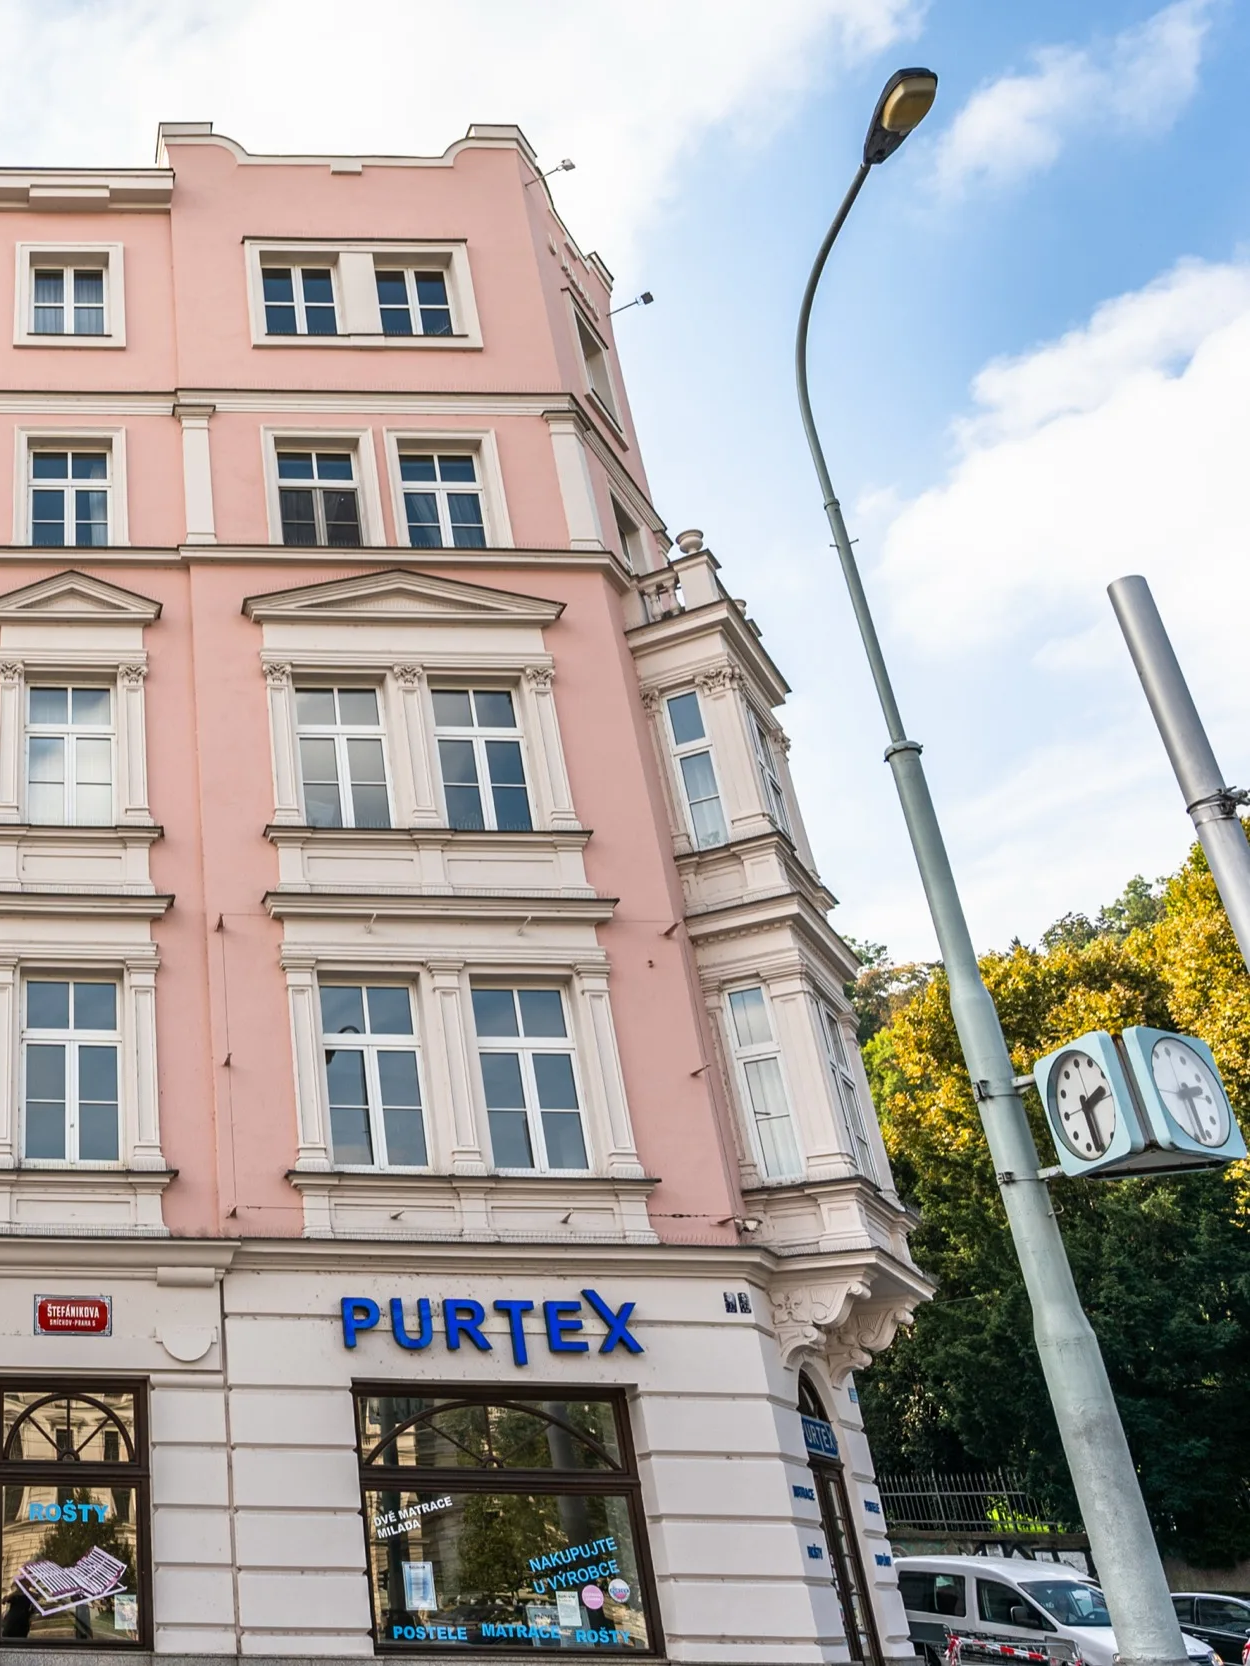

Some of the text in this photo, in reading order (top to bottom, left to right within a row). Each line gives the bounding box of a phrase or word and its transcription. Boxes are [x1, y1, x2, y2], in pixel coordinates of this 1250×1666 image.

[47, 1303, 100, 1319] ŠTEFÁNIKOVA
[340, 1289, 645, 1367] PURTEX
[802, 1422, 836, 1452] URTEX
[28, 1500, 110, 1523] ROŠTY
[398, 1496, 453, 1520] MATRACE
[376, 1518, 422, 1539] MILADA
[529, 1537, 618, 1572] NAKUPUJTE
[533, 1559, 621, 1594] U VÝROBCE
[393, 1623, 632, 1644] POSTELE MATRACE ROŠTY
